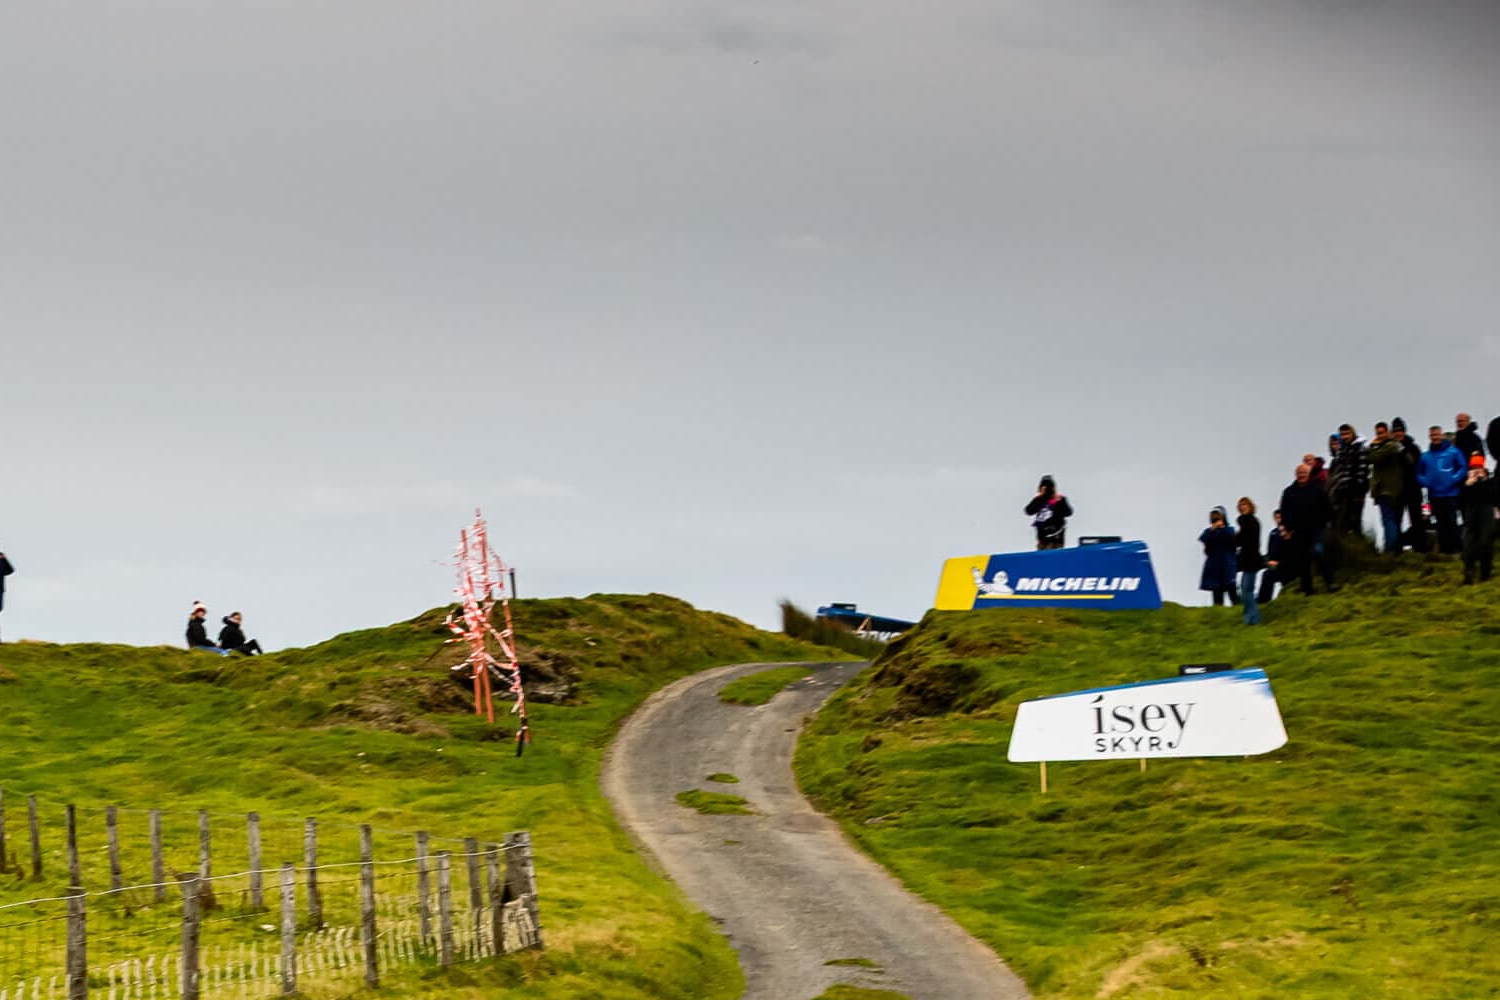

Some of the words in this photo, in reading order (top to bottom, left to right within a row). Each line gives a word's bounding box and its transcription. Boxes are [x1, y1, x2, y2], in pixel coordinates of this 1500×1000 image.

[1014, 576, 1141, 592] MICHELIN
[1091, 694, 1196, 749] ísey
[1095, 736, 1162, 752] SKYR
